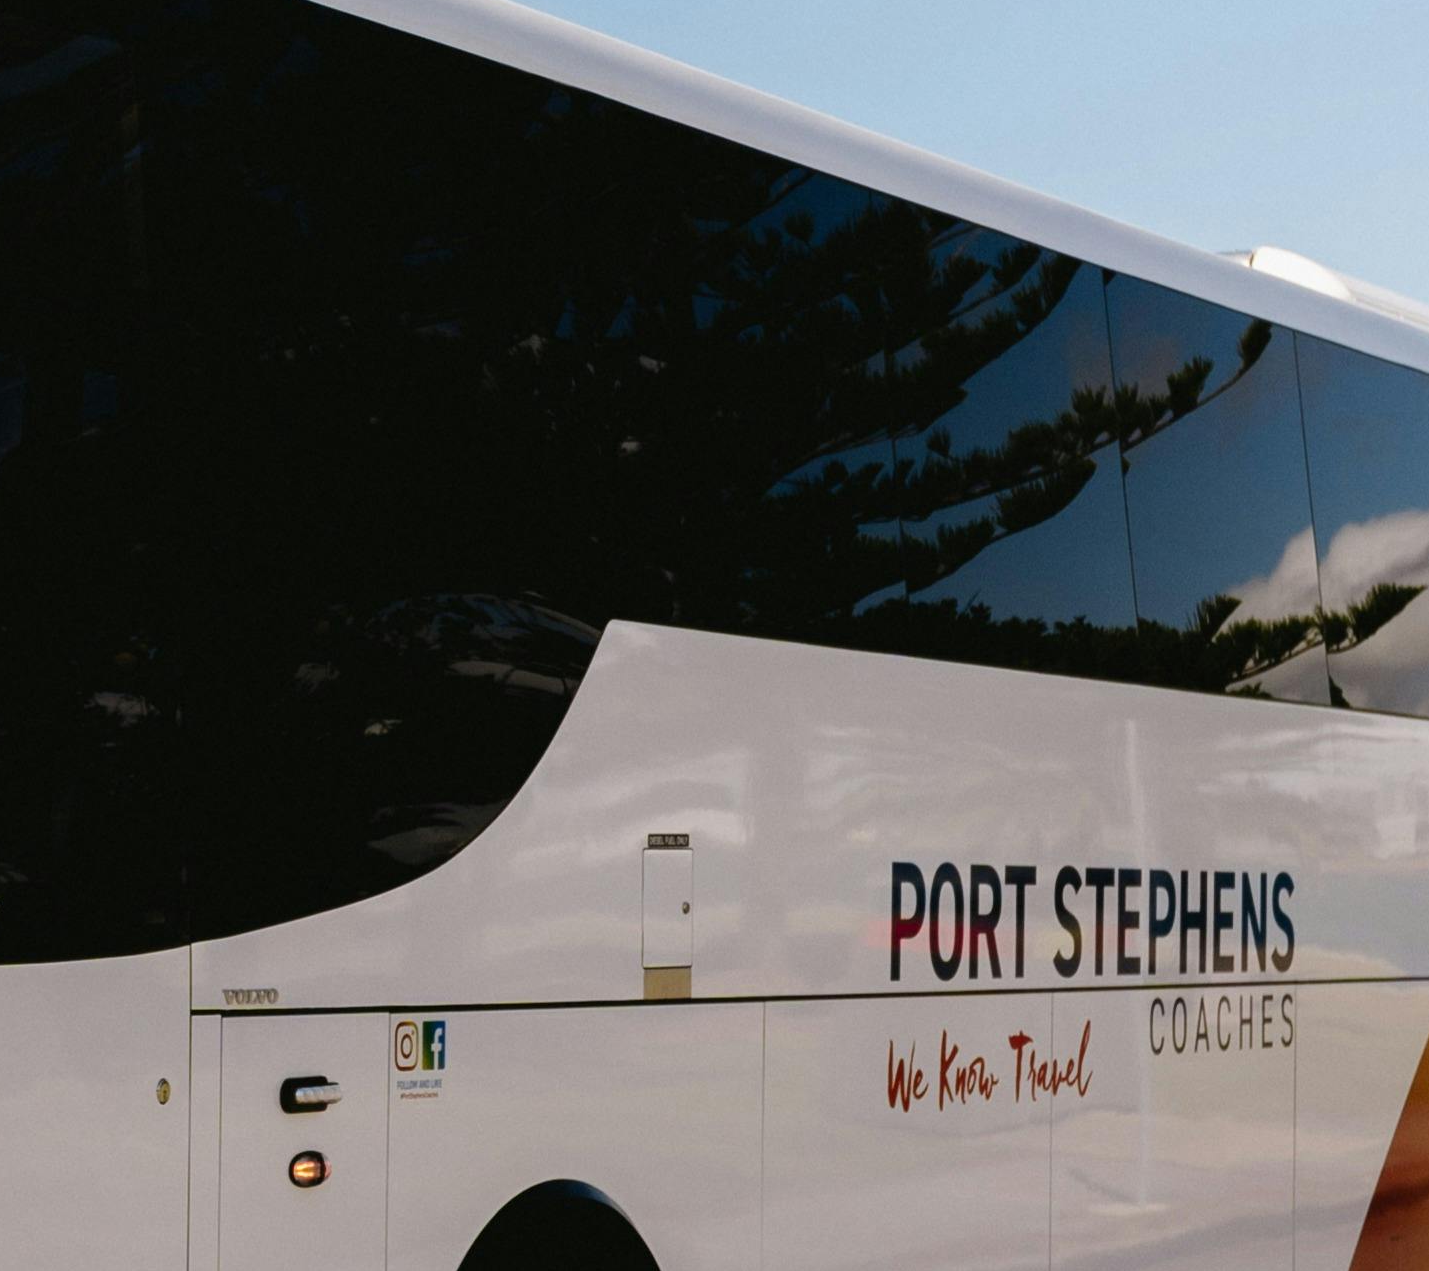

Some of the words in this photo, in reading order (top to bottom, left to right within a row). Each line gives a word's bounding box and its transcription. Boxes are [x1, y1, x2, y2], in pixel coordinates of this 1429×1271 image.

[890, 861, 1036, 982] PORT
[1053, 865, 1295, 978] STEPHENS
[221, 988, 279, 1005] VOLVO
[1150, 994, 1295, 1055] COACHES
[887, 1039, 929, 1112] We
[939, 1029, 999, 1112] Know
[1008, 1019, 1093, 1103] Travel
